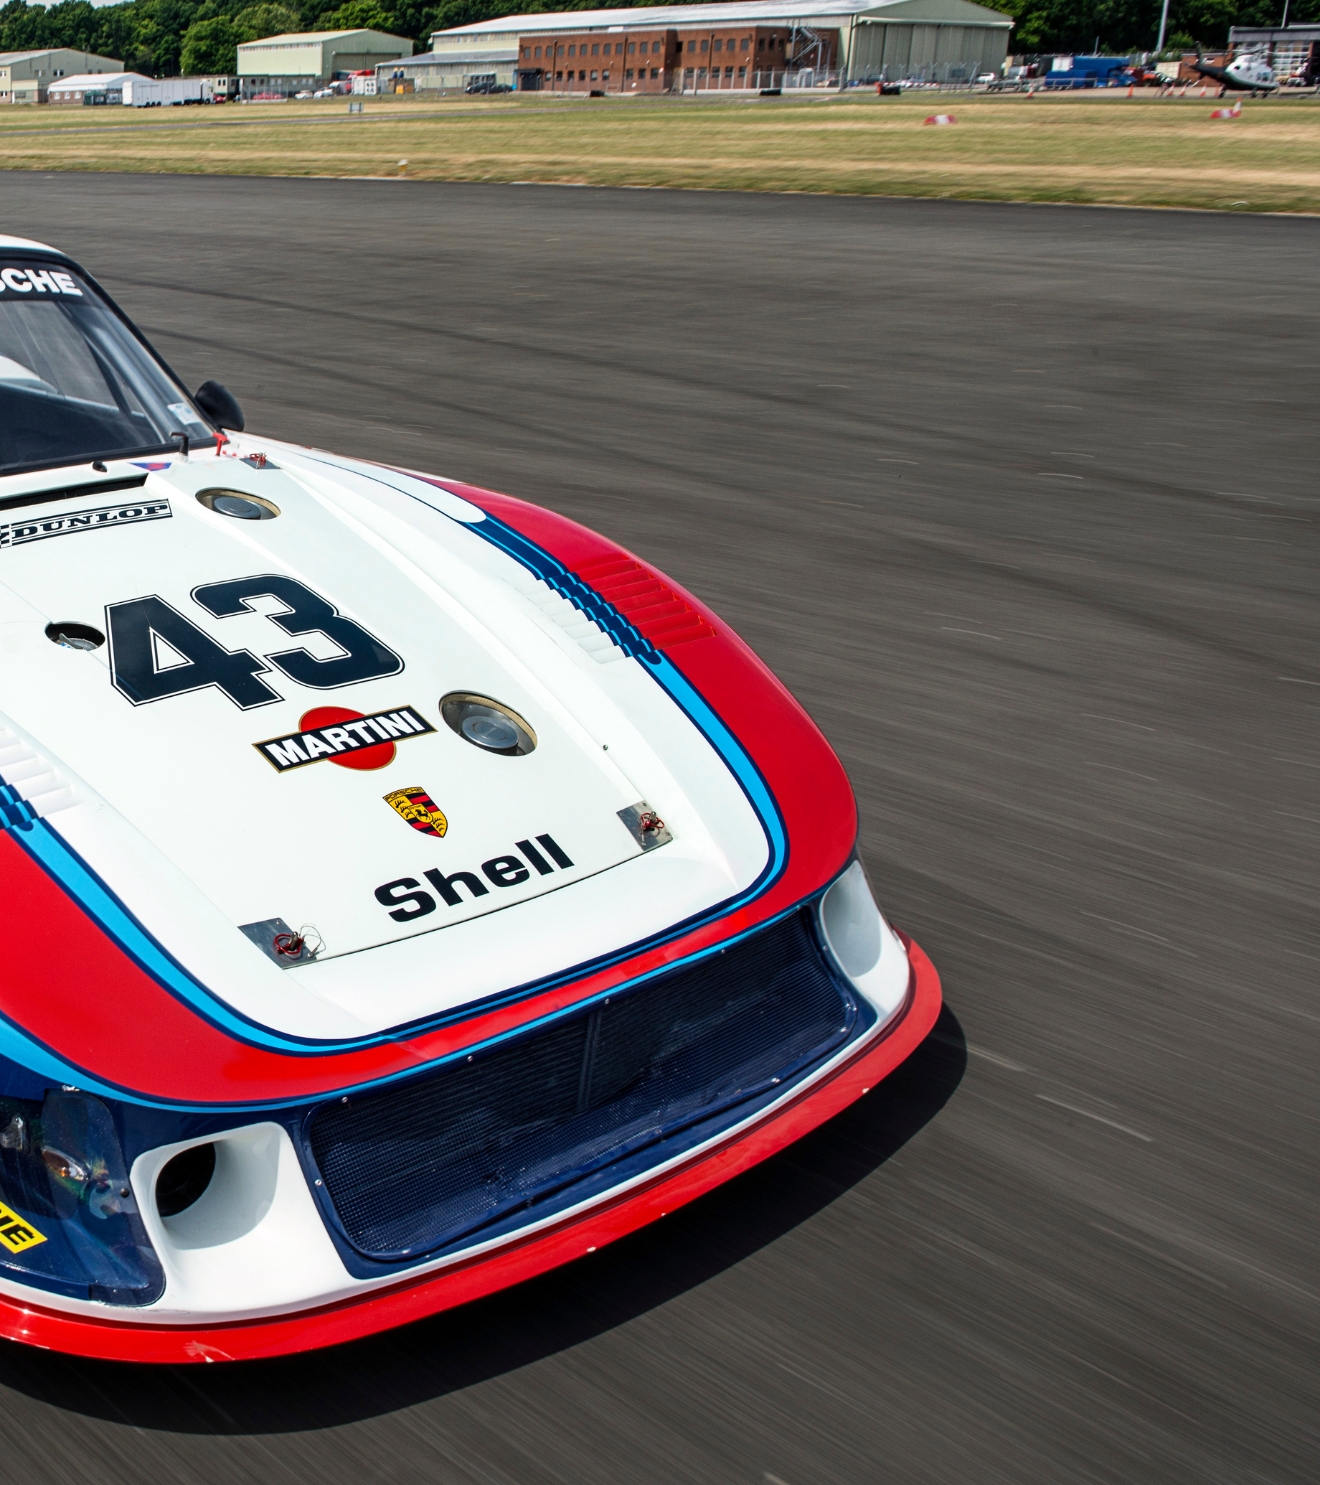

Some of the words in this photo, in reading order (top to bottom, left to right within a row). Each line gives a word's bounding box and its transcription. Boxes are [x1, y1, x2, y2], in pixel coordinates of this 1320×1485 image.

[11, 504, 168, 539] DUNLOP
[104, 573, 405, 711] 43
[265, 710, 425, 767] MARTINI
[374, 833, 575, 923] Shell
